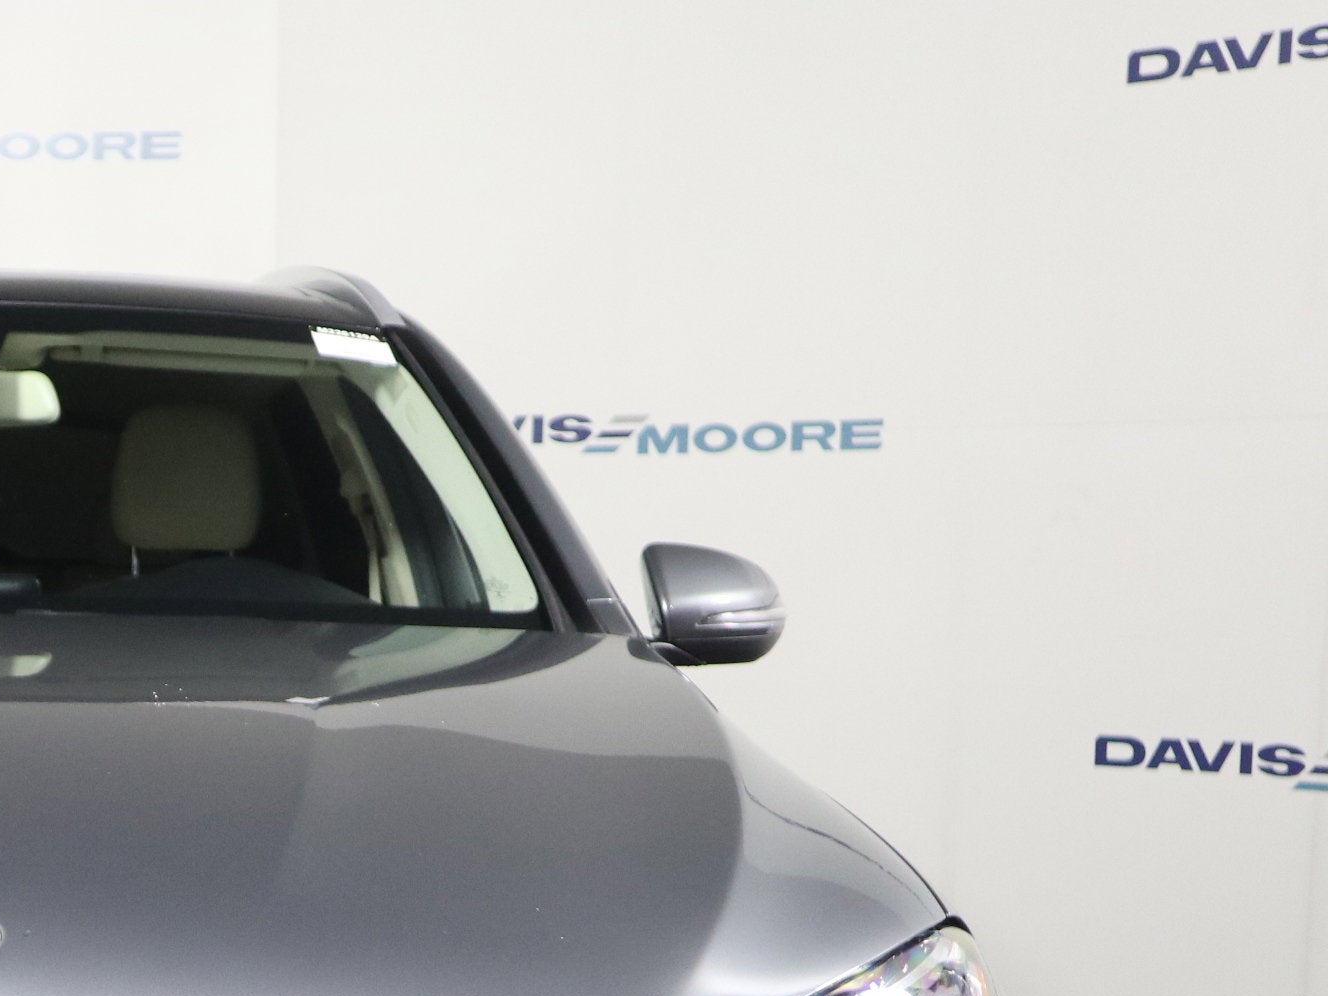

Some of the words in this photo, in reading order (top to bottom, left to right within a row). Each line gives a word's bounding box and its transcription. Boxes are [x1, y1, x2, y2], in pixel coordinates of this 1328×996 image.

[1126, 22, 1328, 85] DAVIS
[513, 413, 593, 445] IS
[636, 418, 884, 455] MOORE
[1094, 735, 1306, 778] DAVIS
